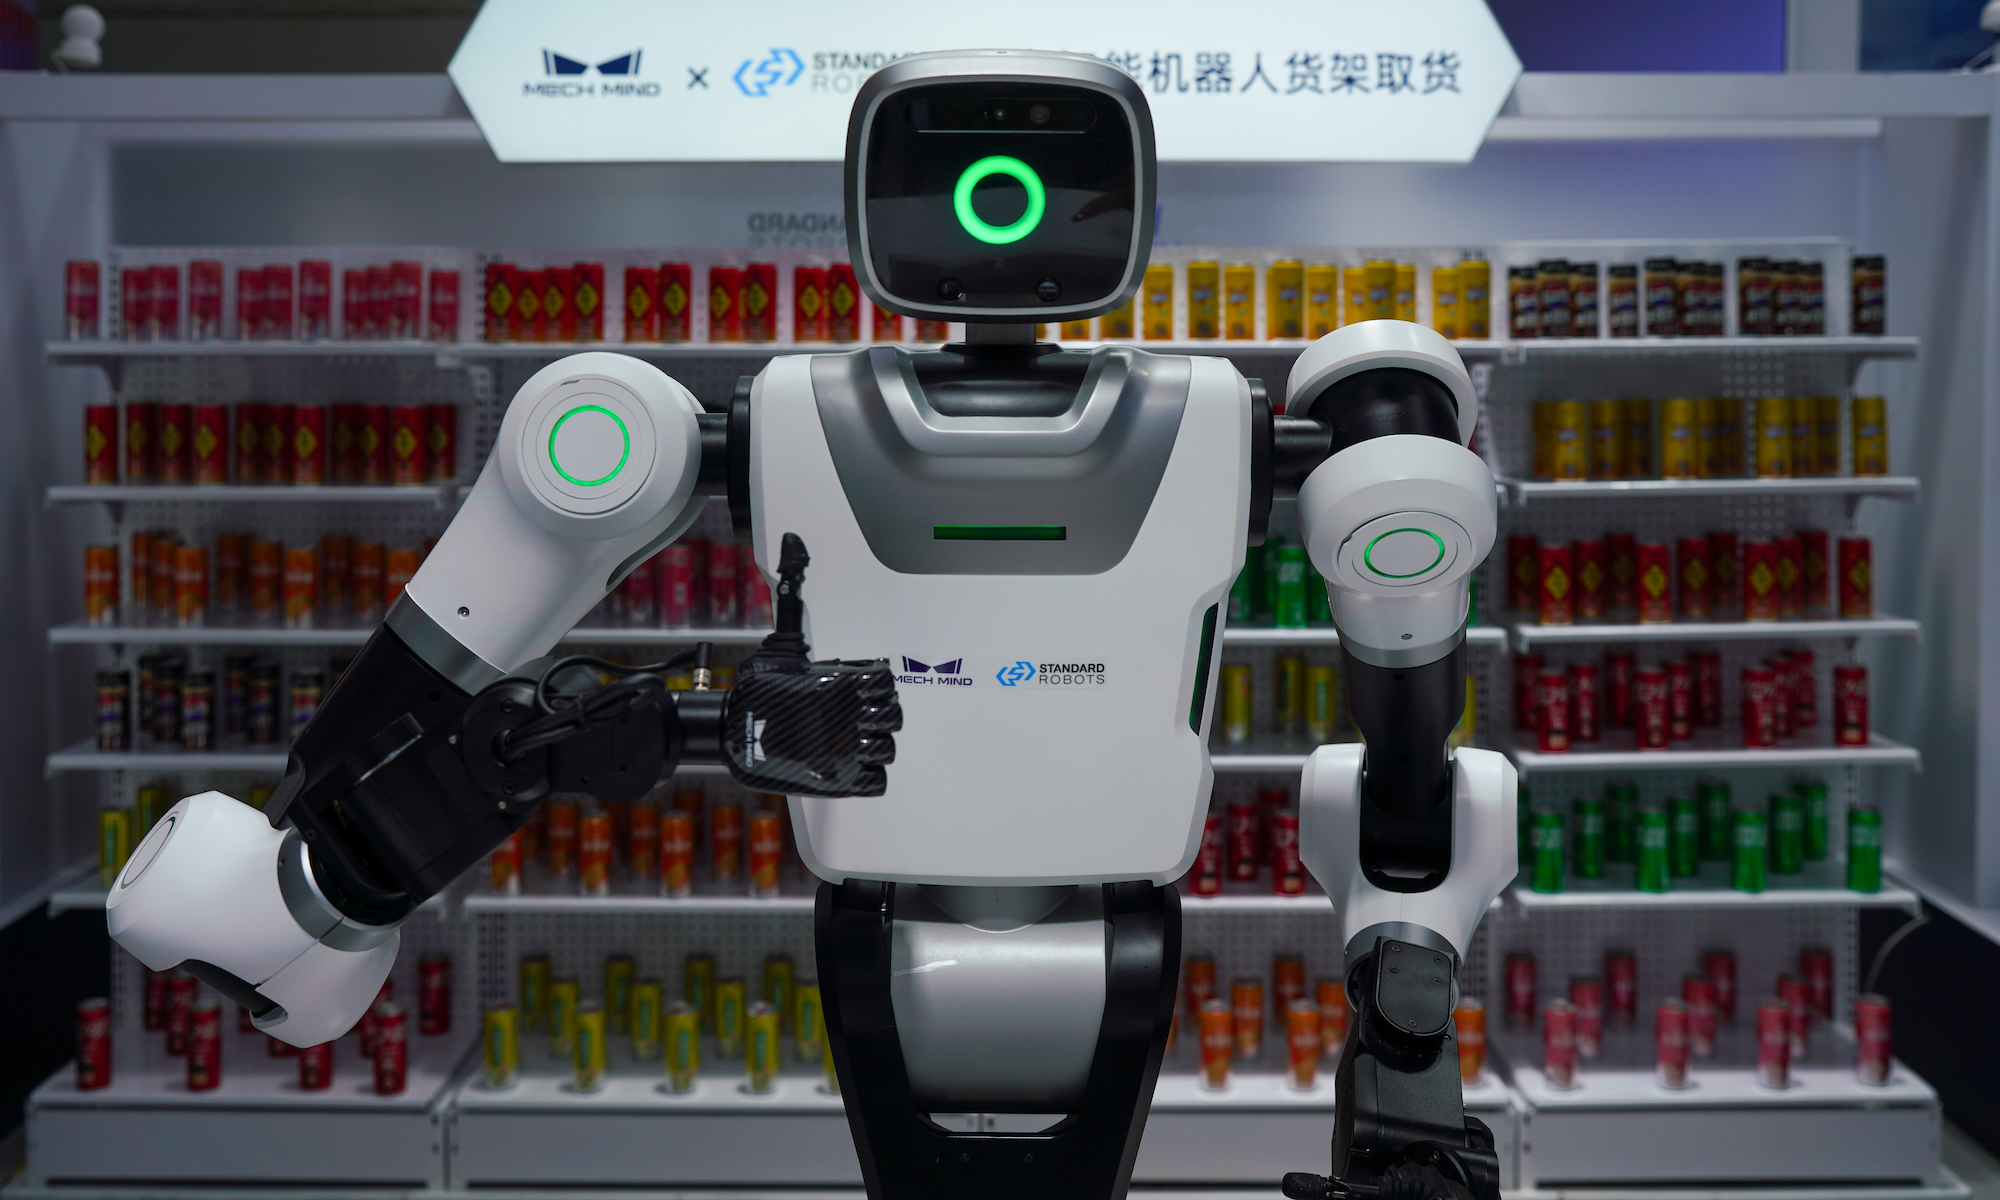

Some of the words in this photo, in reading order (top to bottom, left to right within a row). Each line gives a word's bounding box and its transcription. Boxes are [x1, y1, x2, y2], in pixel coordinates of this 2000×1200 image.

[523, 83, 594, 97] MECH
[601, 83, 660, 97] MIND
[1039, 663, 1105, 673] STANDARD
[892, 675, 933, 685] MECH
[938, 677, 973, 686] MIND
[1039, 674, 1105, 684] ROBOTS
[745, 711, 754, 742] MECH
[745, 743, 754, 768] MIND
